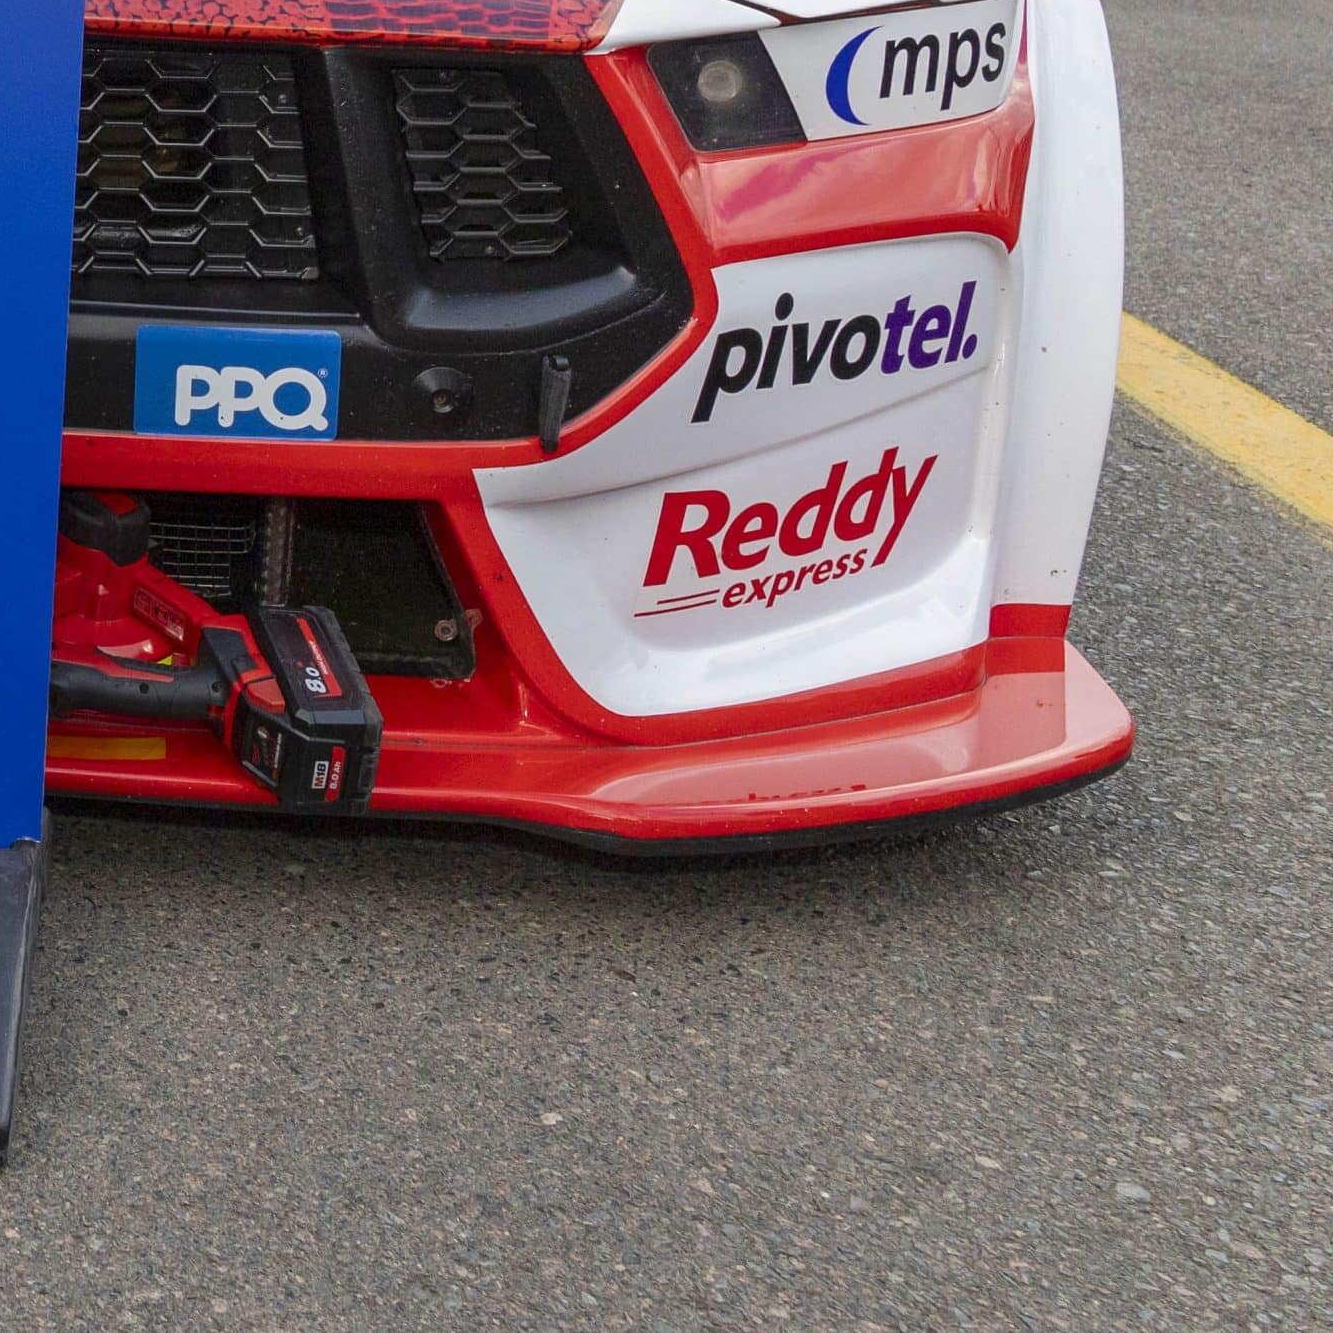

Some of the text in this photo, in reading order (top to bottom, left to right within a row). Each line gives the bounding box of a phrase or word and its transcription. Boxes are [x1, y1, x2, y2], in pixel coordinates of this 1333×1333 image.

[879, 20, 1006, 112] mps
[174, 364, 329, 432] PPQ
[642, 445, 939, 588] Reddy
[721, 548, 869, 609] express
[304, 666, 327, 694] 8.0
[312, 761, 329, 789] M18
